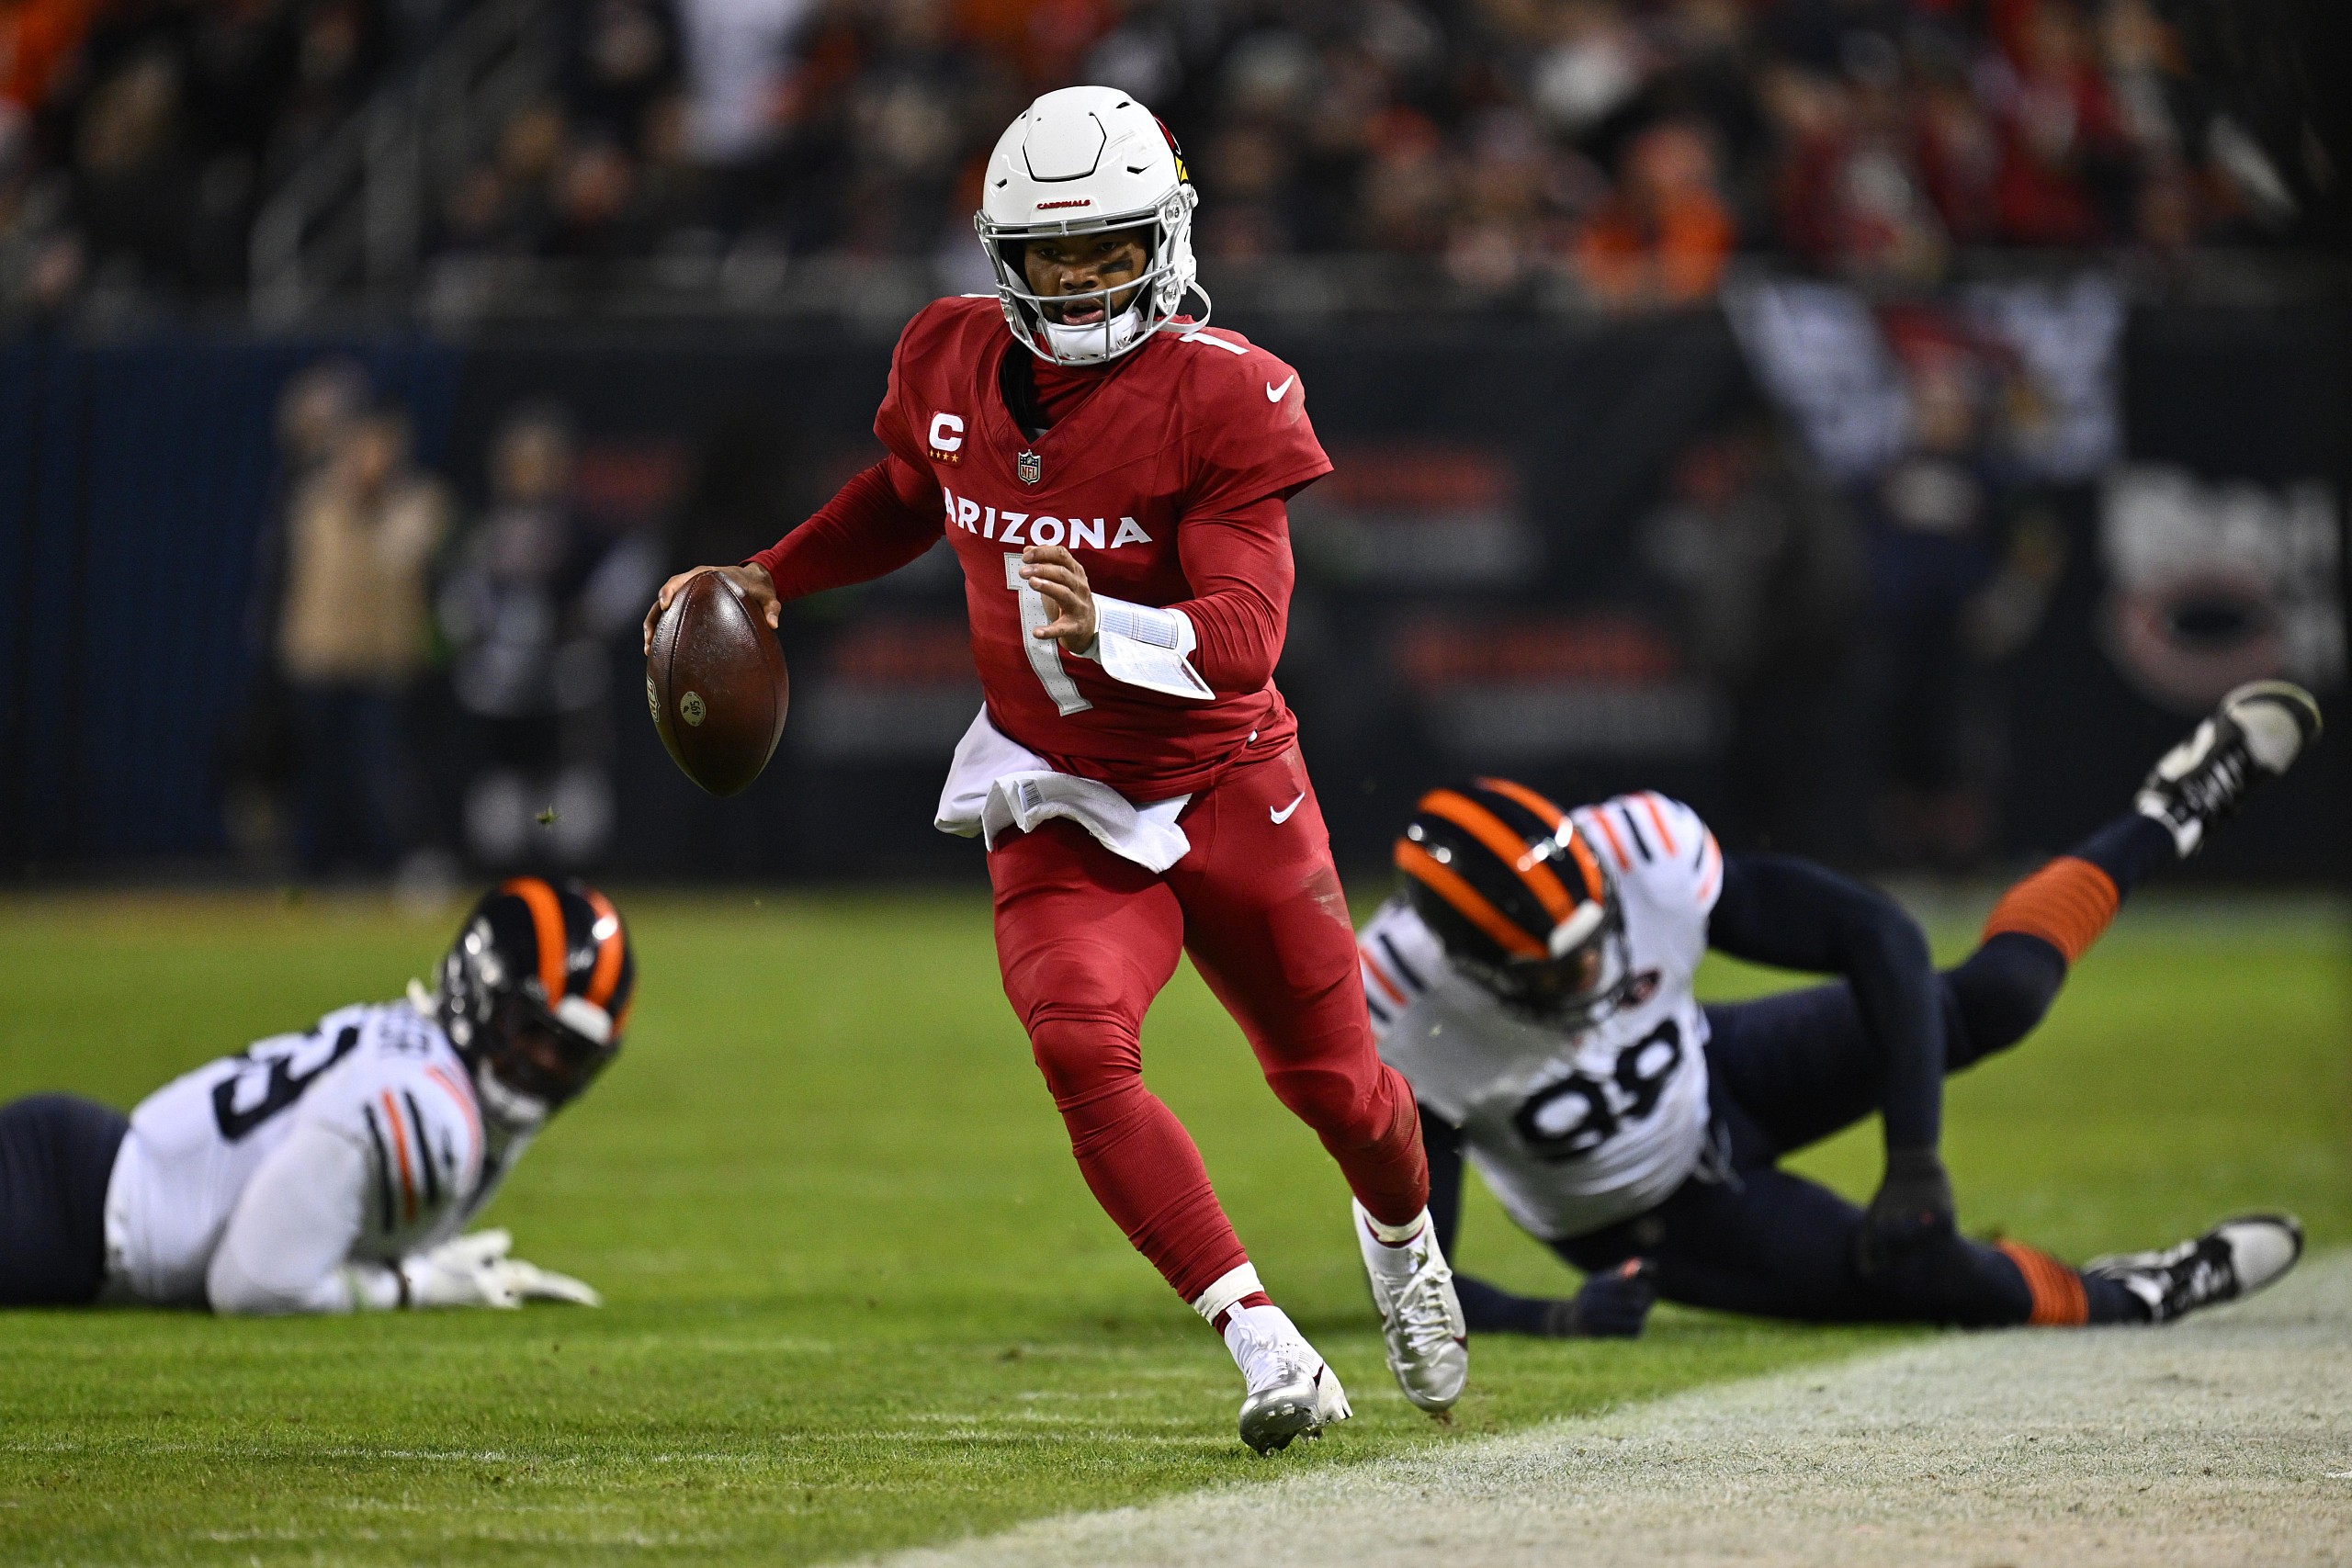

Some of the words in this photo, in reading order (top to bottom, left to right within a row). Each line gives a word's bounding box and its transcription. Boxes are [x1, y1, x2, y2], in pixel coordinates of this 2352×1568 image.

[929, 412, 965, 452] C
[1021, 466, 1038, 479] NFL
[944, 487, 1153, 549] ARIZONA
[1004, 552, 1093, 716] 1
[690, 701, 701, 716] 495
[1516, 1017, 1681, 1162] 99
